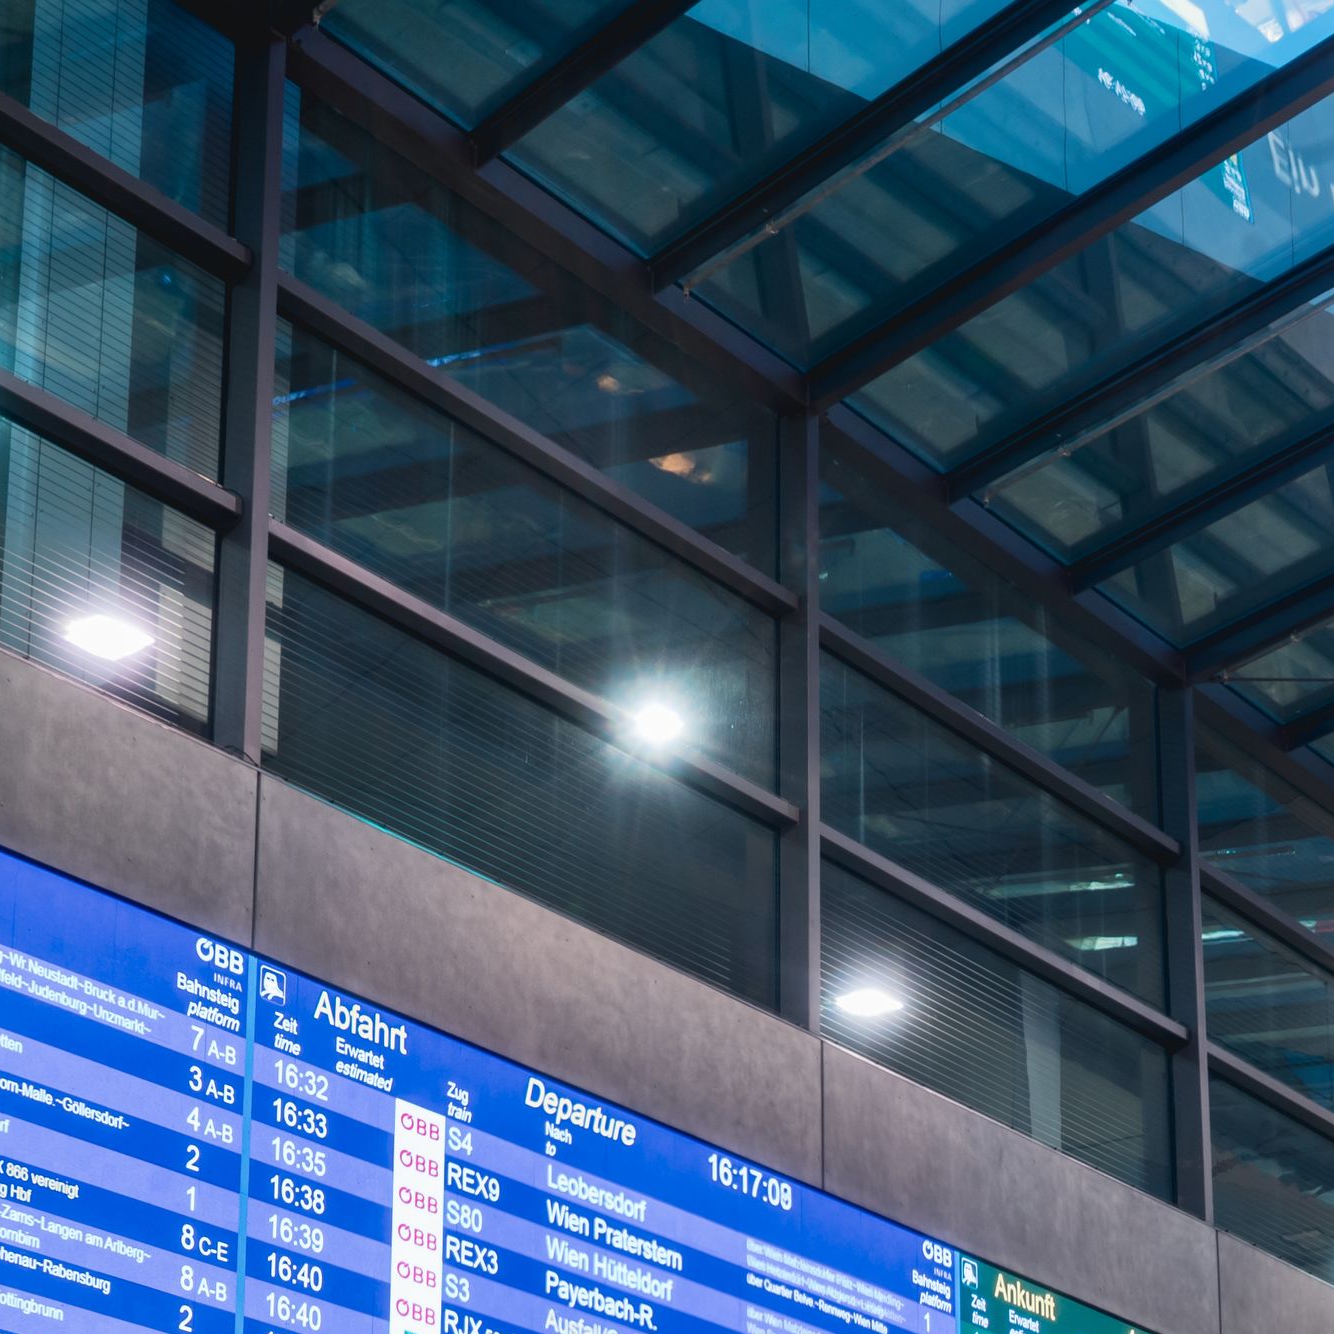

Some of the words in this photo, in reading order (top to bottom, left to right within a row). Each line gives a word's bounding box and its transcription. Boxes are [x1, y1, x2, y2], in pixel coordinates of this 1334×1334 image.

[274, 1059, 329, 1101] 16:32
[5, 1161, 29, 1182] 866
[30, 1172, 79, 1200] vereinigt
[9, 1183, 32, 1203] Hbf
[180, 1223, 195, 1250] 8
[198, 1235, 229, 1263] C-E
[545, 1234, 589, 1272] Wien
[593, 1252, 673, 1301] Hütteldorf
[395, 1297, 436, 1326] ÖBB
[994, 1273, 1056, 1321] Ankunft
